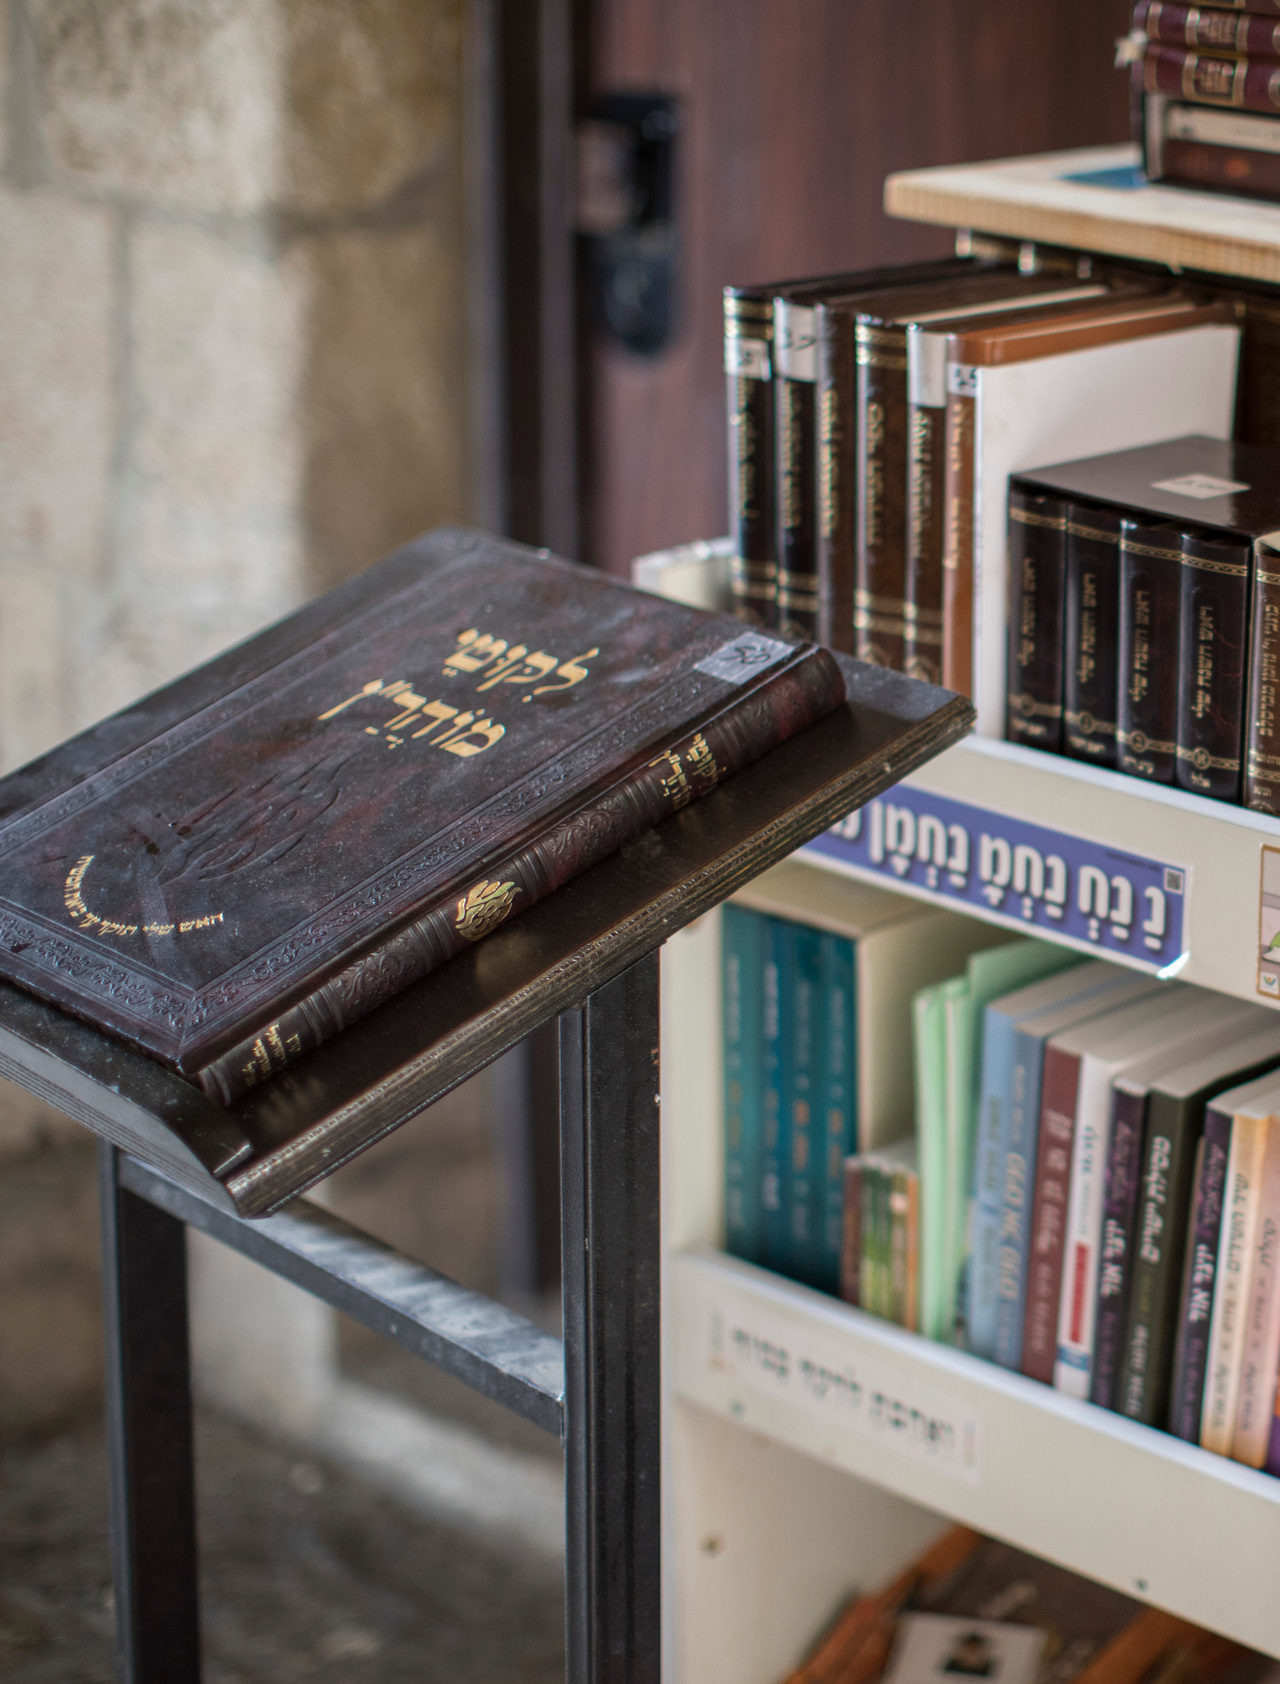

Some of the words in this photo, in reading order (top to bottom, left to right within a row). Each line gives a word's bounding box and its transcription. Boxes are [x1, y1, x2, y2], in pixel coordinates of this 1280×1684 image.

[1198, 606, 1213, 640] ראש
[1264, 604, 1279, 635] כתבי
[1197, 645, 1212, 686] השנה
[1262, 653, 1279, 682] נחמן
[1191, 690, 1211, 718] שלי
[1256, 685, 1275, 737] מברסלב
